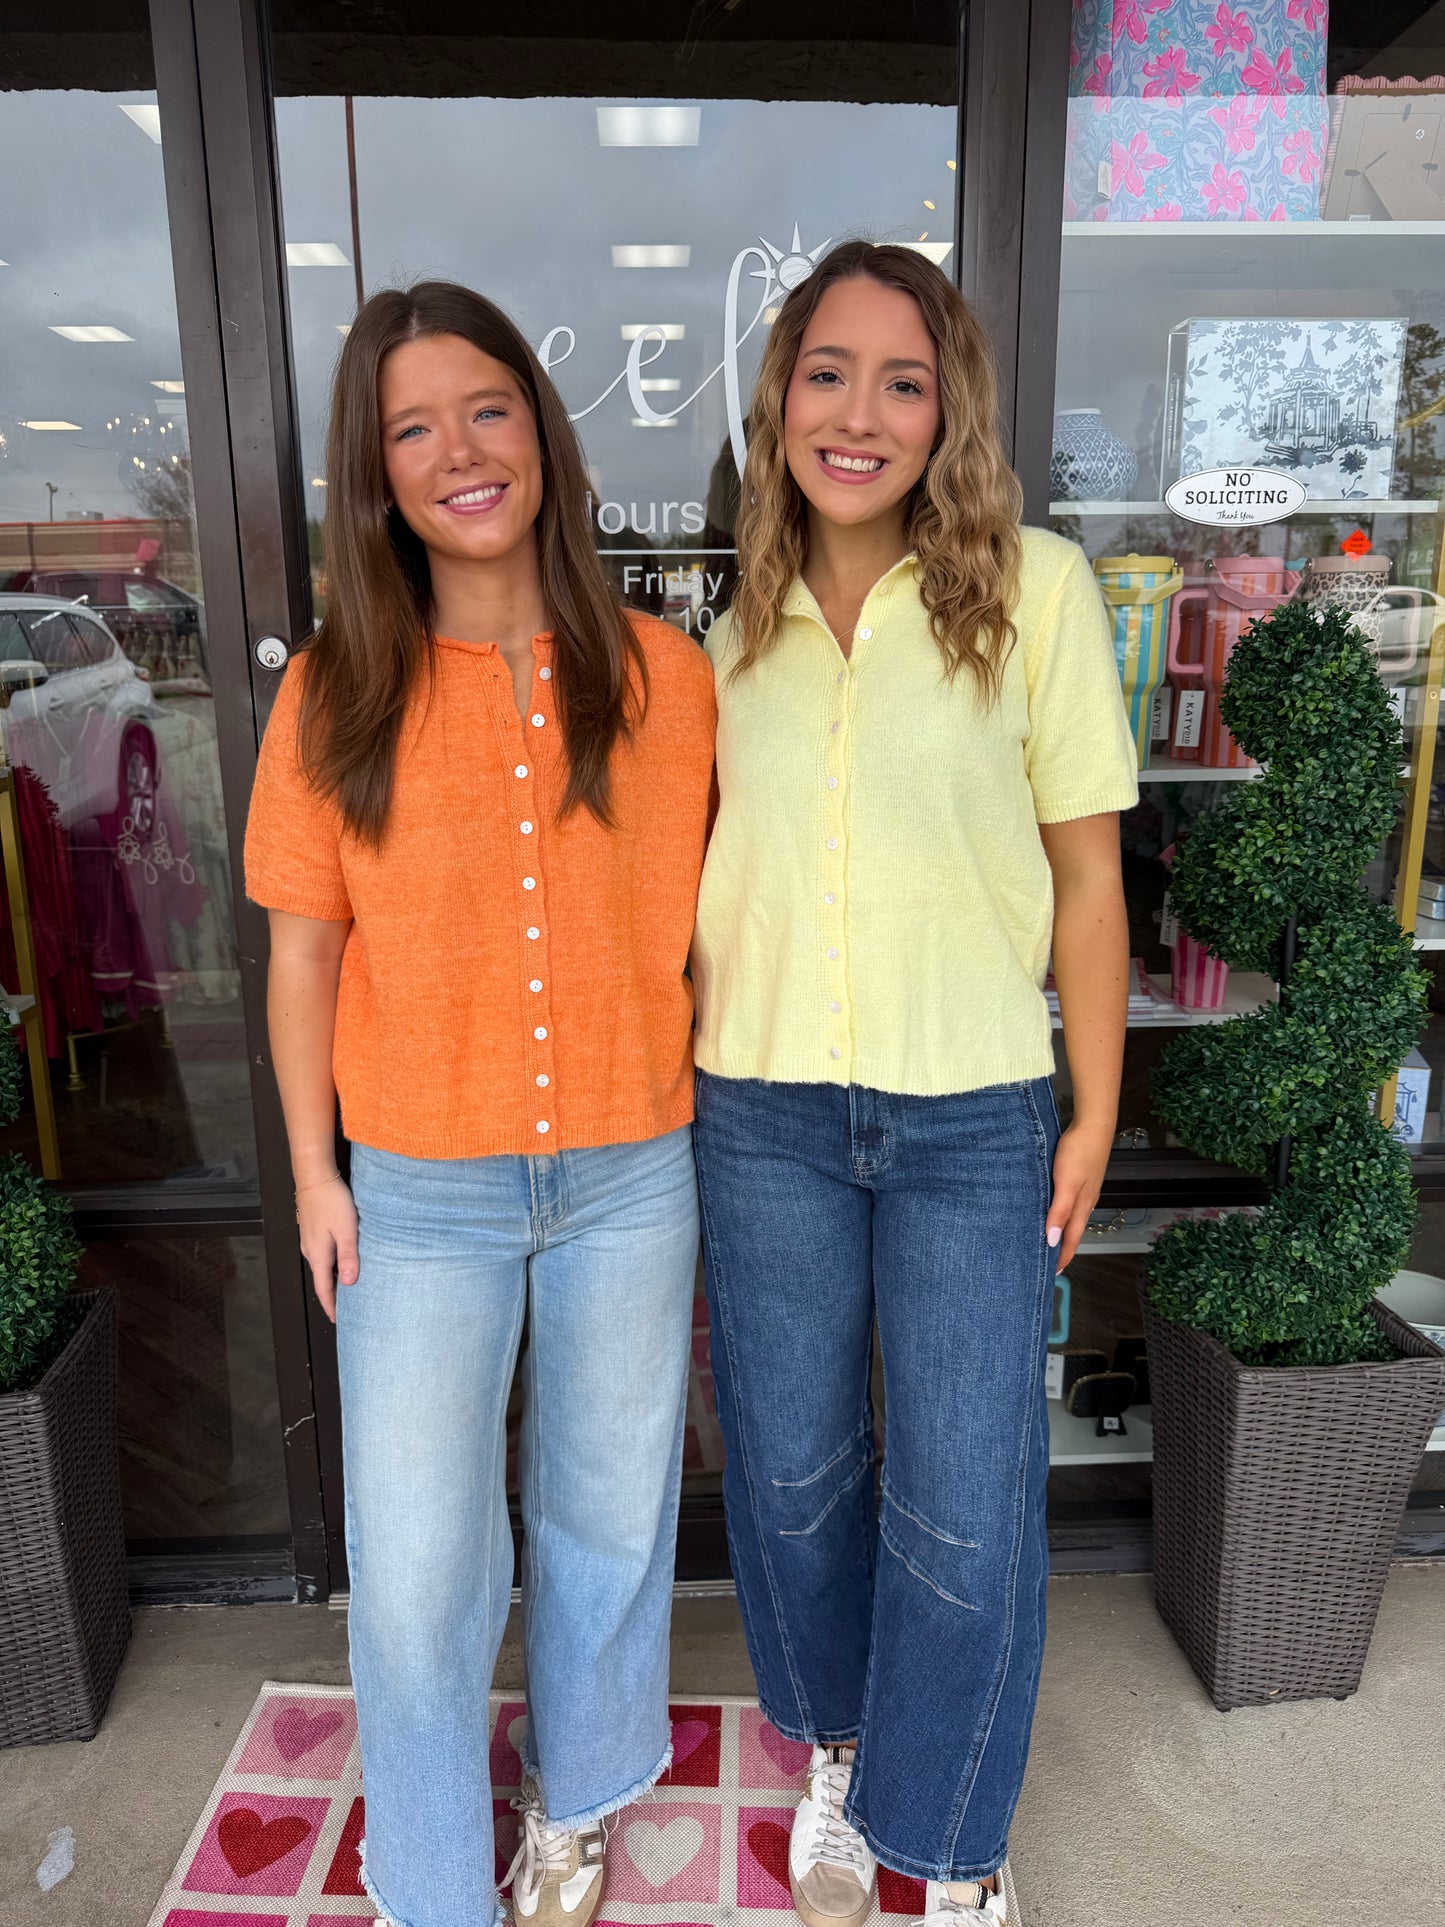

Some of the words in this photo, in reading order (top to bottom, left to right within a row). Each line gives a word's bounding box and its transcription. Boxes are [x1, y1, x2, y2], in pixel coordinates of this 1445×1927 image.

[1225, 473, 1251, 487] NO
[1185, 490, 1288, 505] SOLICITING
[1216, 510, 1238, 520] Thank
[1240, 511, 1255, 522] You
[623, 565, 725, 601] Friday
[1184, 702, 1195, 744] KATYDID
